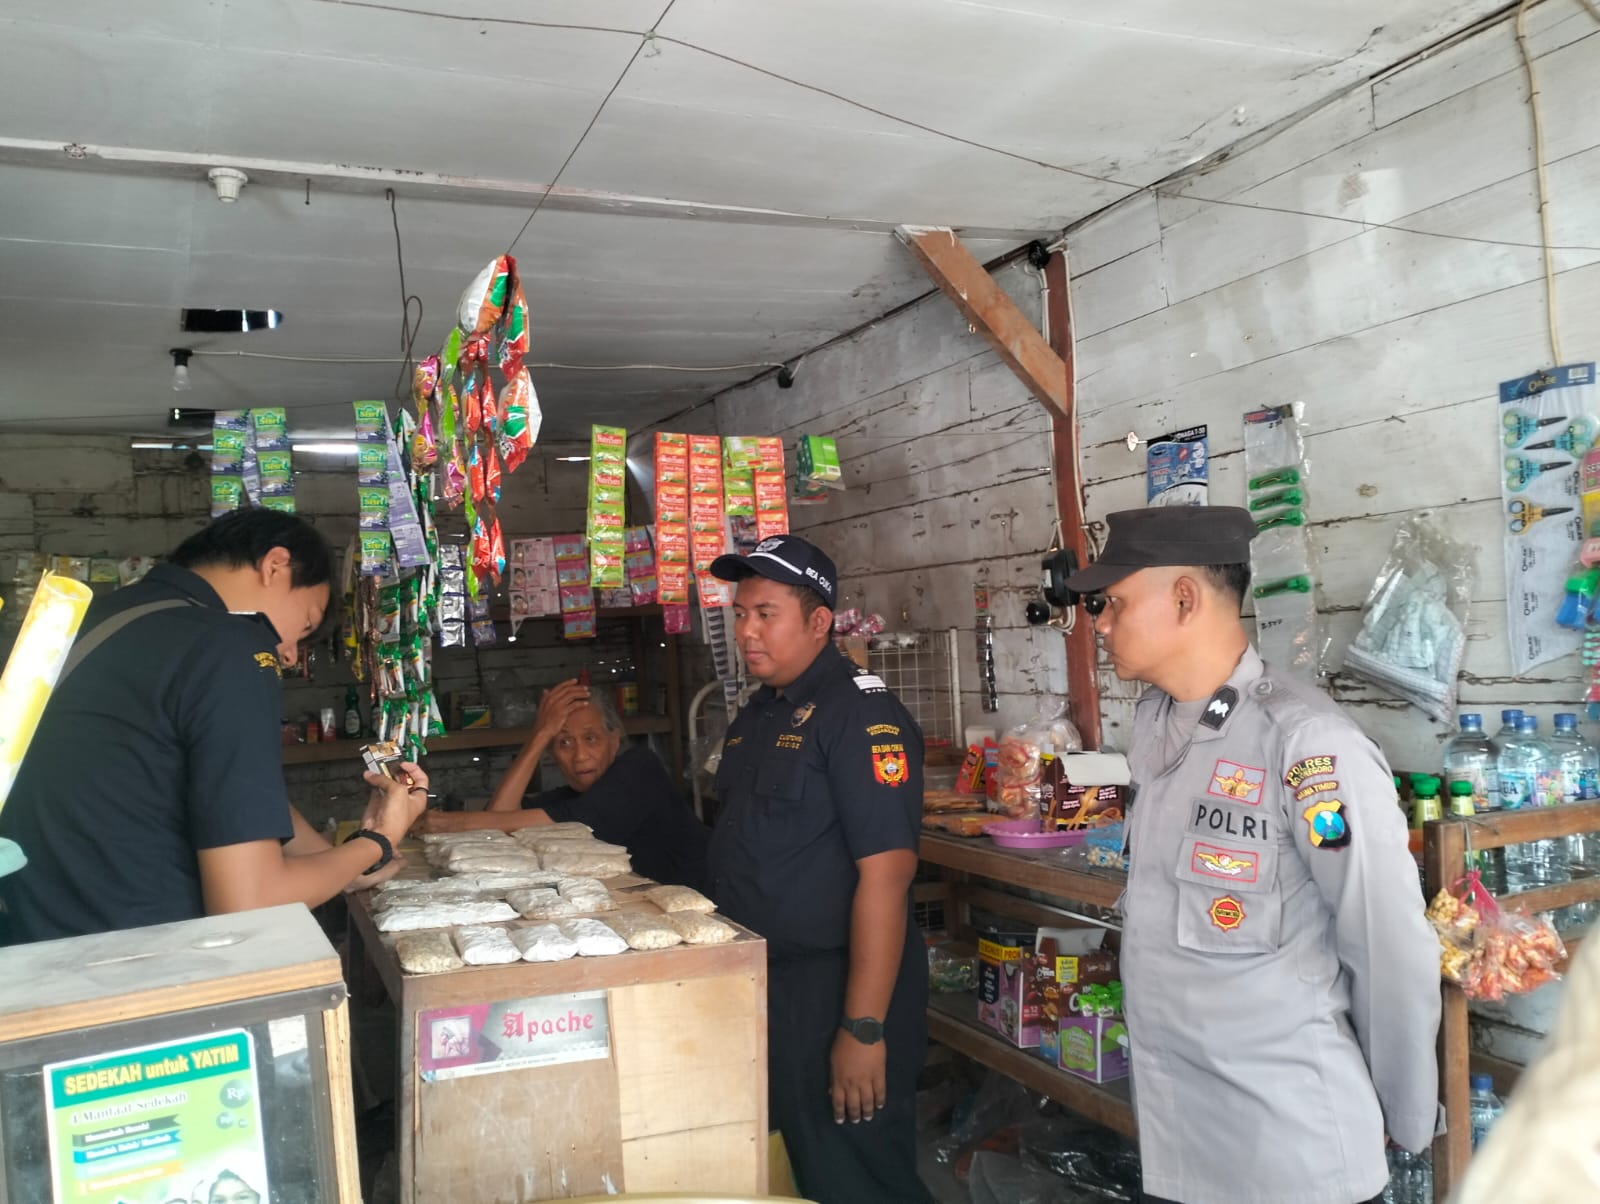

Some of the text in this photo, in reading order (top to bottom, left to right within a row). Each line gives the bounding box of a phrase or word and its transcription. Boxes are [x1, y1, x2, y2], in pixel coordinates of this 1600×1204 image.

[805, 566, 832, 594] BEA CUKA
[1287, 757, 1331, 783] POLRES
[1313, 781, 1338, 793] TIMUR
[1195, 804, 1267, 840] POLRI
[502, 1009, 594, 1043] Apache
[65, 1044, 239, 1096] SEDEKAH untuk YATIM
[136, 1091, 187, 1109] Sedekah
[226, 1087, 245, 1101] Rp
